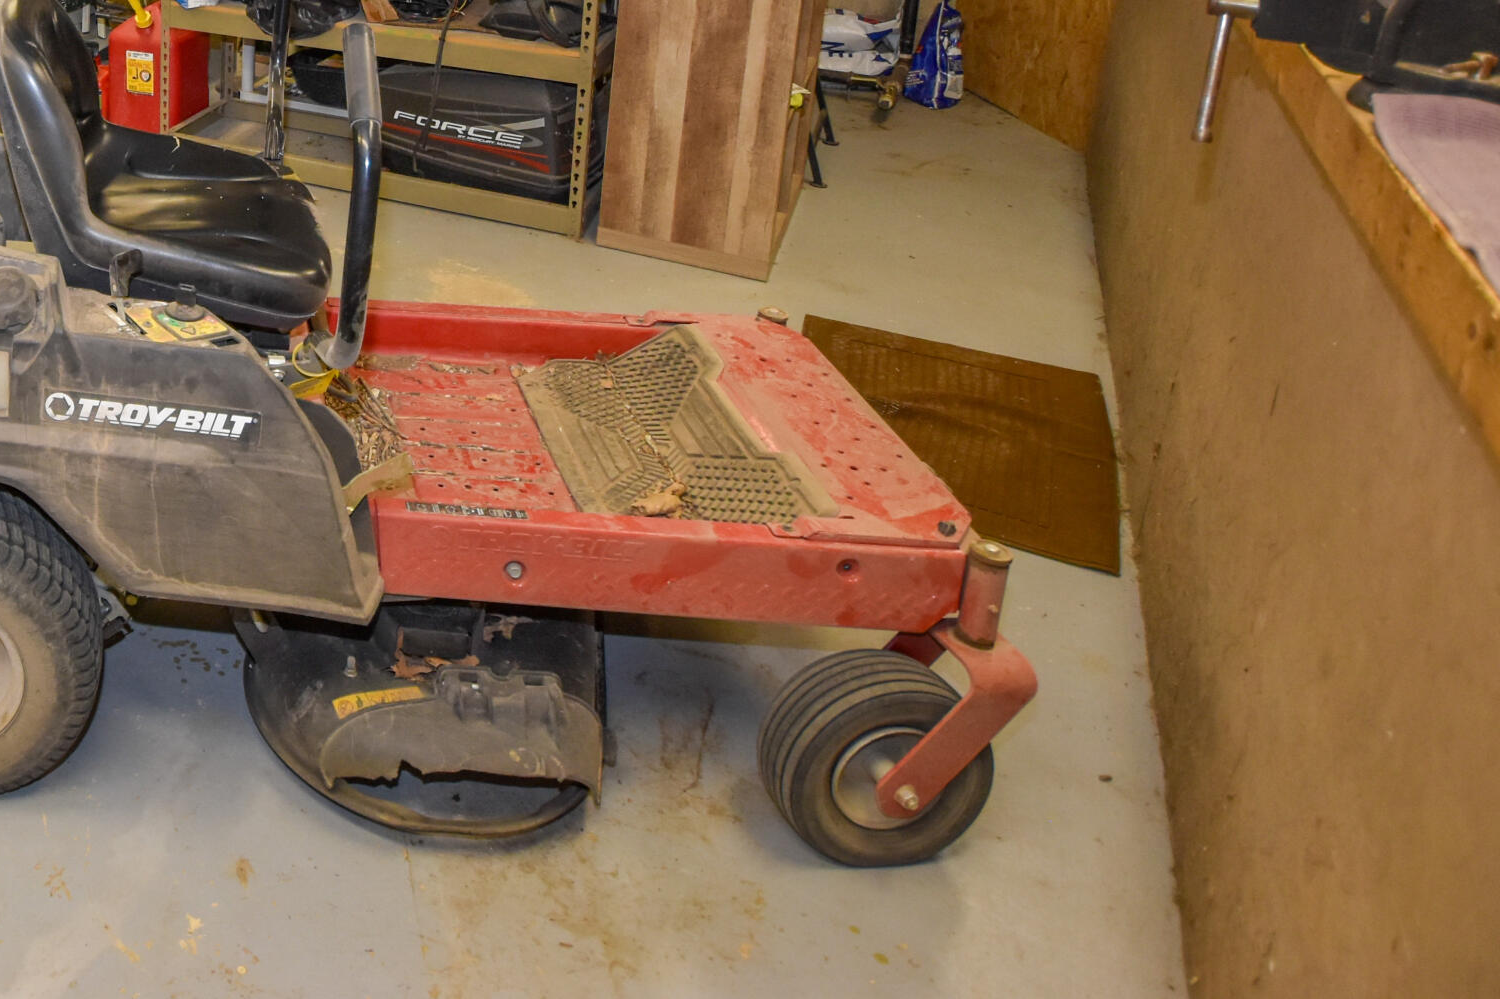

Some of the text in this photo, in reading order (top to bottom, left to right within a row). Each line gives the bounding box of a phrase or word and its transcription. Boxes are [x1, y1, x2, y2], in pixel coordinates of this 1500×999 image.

[393, 110, 525, 145] FORCE
[466, 136, 495, 145] MERCURY
[496, 141, 521, 149] MARINE
[78, 398, 254, 438] TROY-BILT
